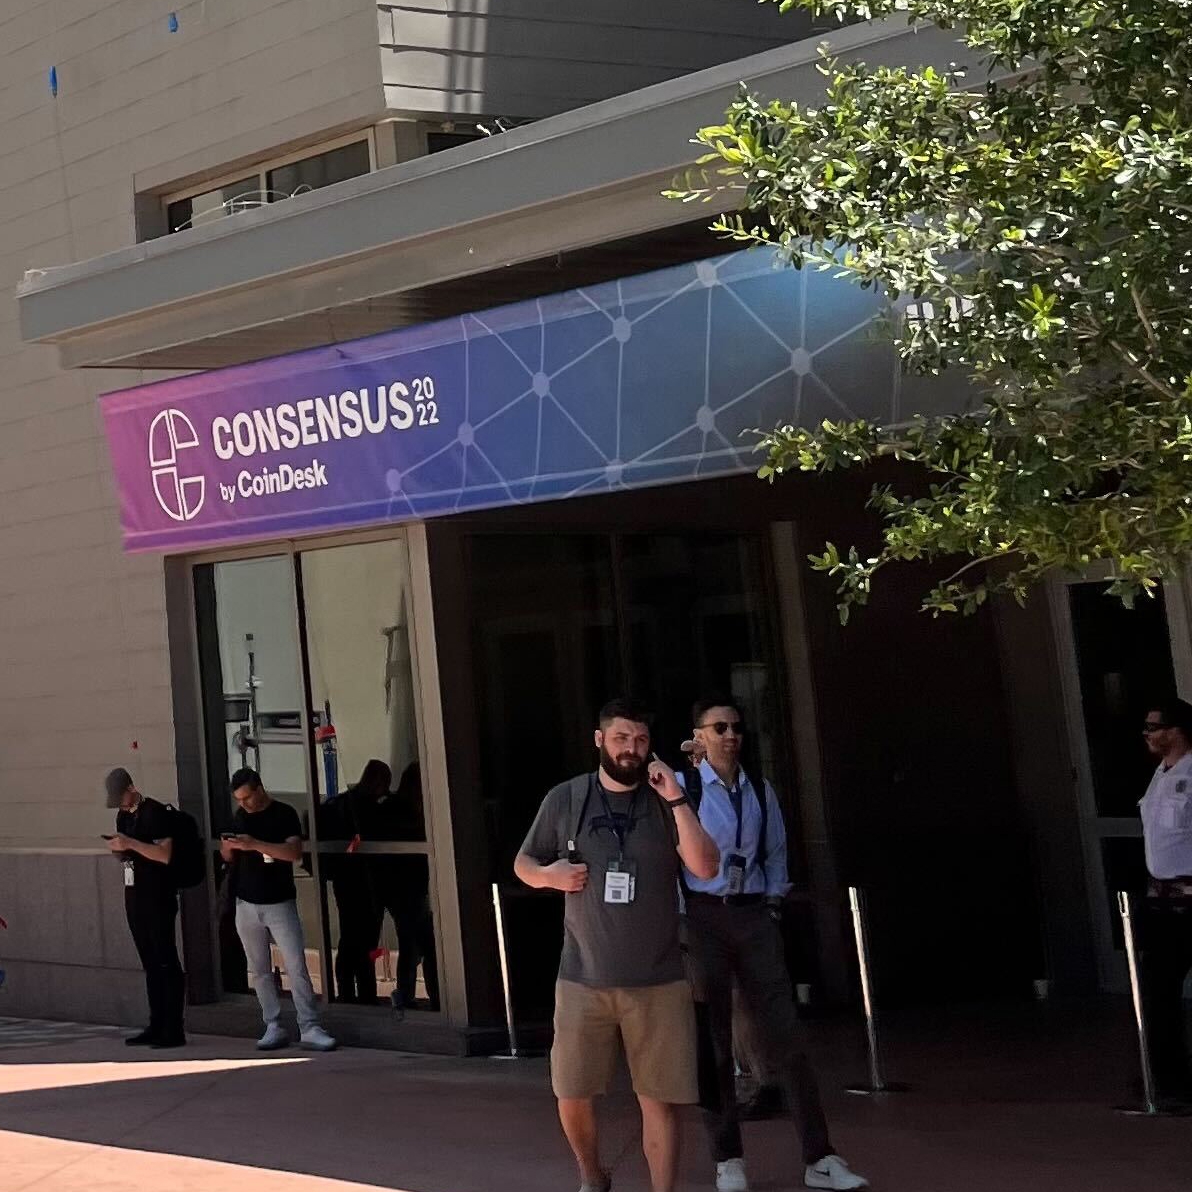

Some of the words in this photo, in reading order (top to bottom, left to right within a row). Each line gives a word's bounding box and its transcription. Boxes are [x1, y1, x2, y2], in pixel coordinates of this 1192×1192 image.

[411, 376, 434, 401] 20
[212, 381, 415, 460] CONSENSUS
[416, 401, 439, 426] 22
[219, 482, 236, 503] by
[237, 459, 328, 498] CoinDesk
